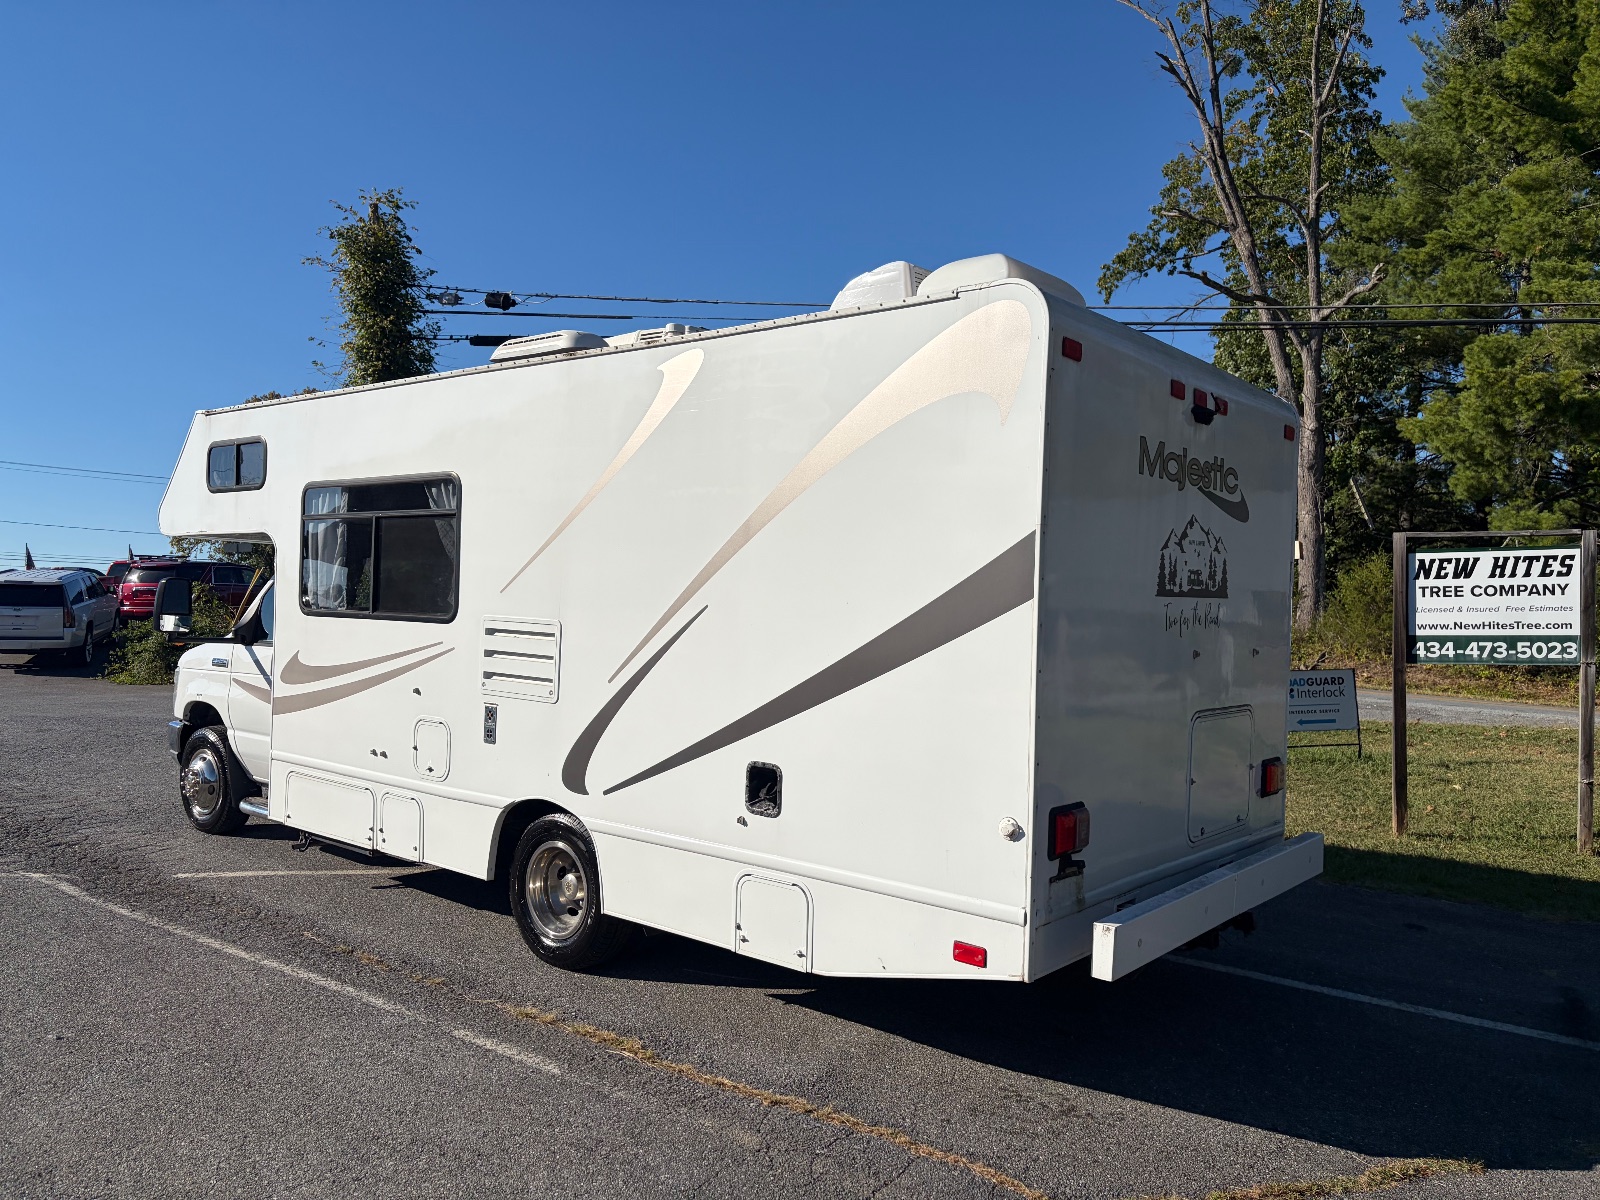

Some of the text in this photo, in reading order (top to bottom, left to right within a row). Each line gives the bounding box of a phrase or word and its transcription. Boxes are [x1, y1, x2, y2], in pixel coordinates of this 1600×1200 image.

[1138, 435, 1239, 495] Majestic
[1413, 554, 1577, 580] NEW HITES
[1418, 583, 1570, 598] TREE COMPANY
[1190, 600, 1202, 628] the
[1416, 604, 1574, 614] Licensed & Insured Free Estimates
[1416, 620, 1573, 630] www.NewHitesTree.com
[1412, 641, 1578, 659] 434-473-5023
[1297, 685, 1346, 699] Interlock
